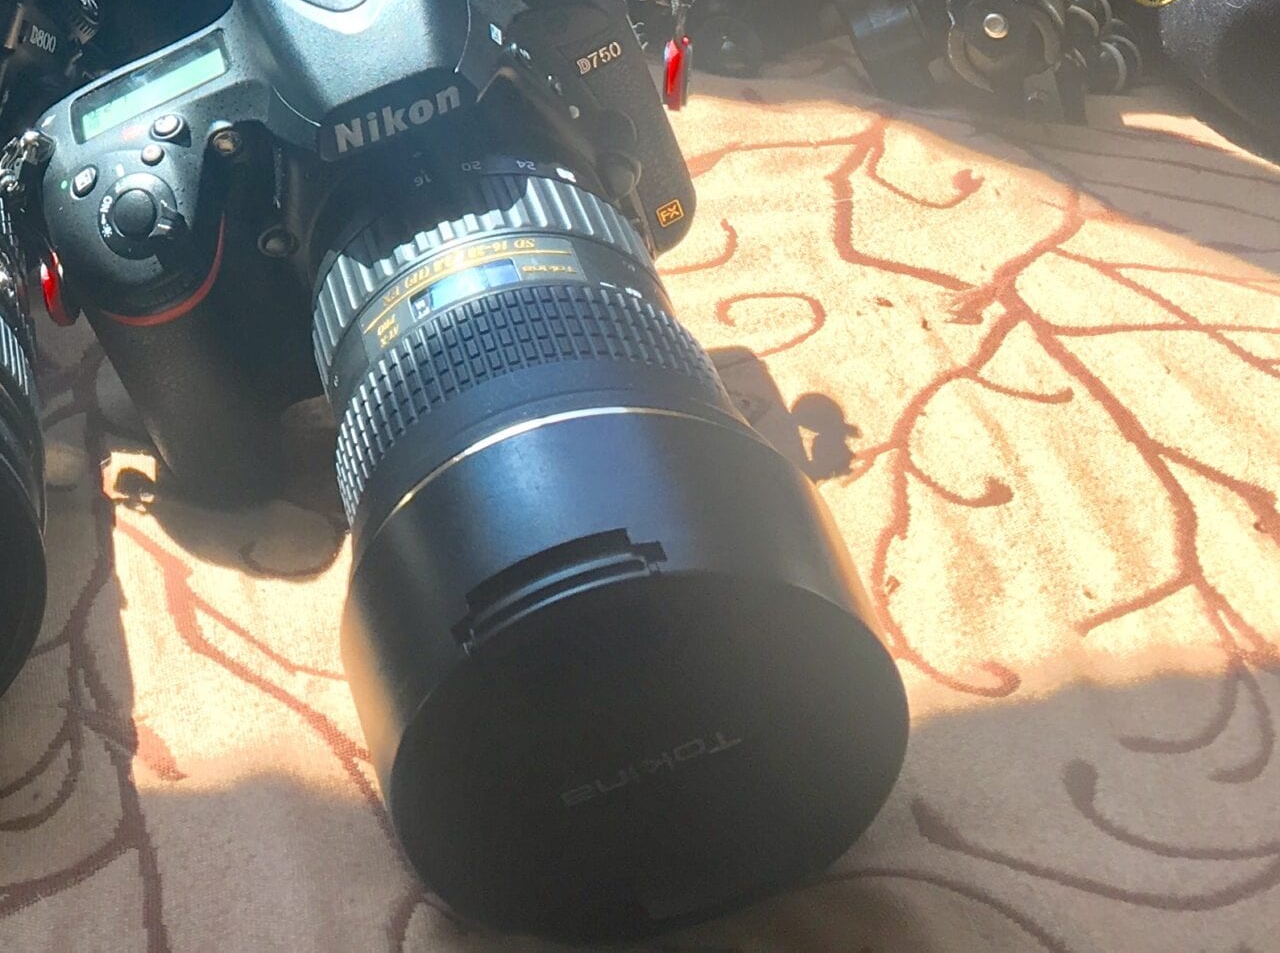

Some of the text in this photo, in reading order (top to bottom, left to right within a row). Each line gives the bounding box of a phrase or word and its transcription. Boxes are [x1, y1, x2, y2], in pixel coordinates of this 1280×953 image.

[30, 24, 57, 54] D800
[576, 40, 622, 76] D750
[334, 85, 461, 154] Nikon
[461, 159, 482, 172] 20
[659, 201, 680, 226] FX
